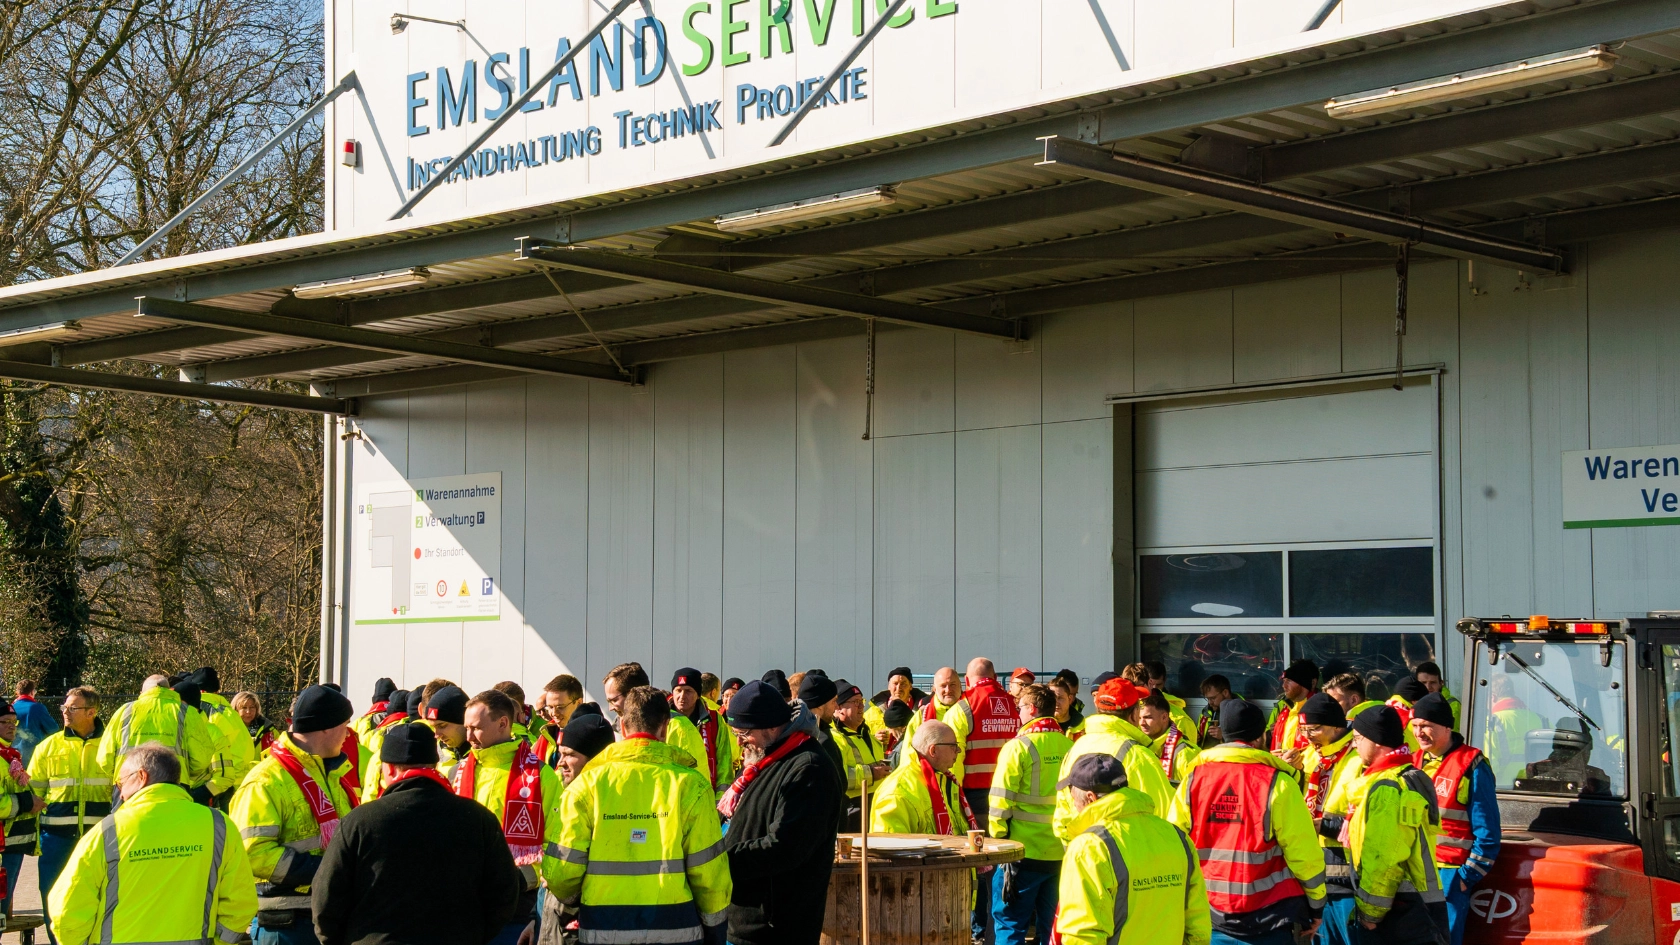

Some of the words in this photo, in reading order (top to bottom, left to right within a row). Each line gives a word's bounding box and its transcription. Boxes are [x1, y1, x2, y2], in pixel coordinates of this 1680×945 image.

[613, 99, 722, 149] TECHNIK
[1584, 455, 1679, 480] Waren
[426, 485, 495, 501] Warenannahme
[425, 513, 475, 527] Verwaltung
[425, 548, 434, 558] Ihr
[436, 547, 464, 558] Standort
[1210, 803, 1242, 811] ZUKUNT
[1470, 889, 1517, 923] EP
